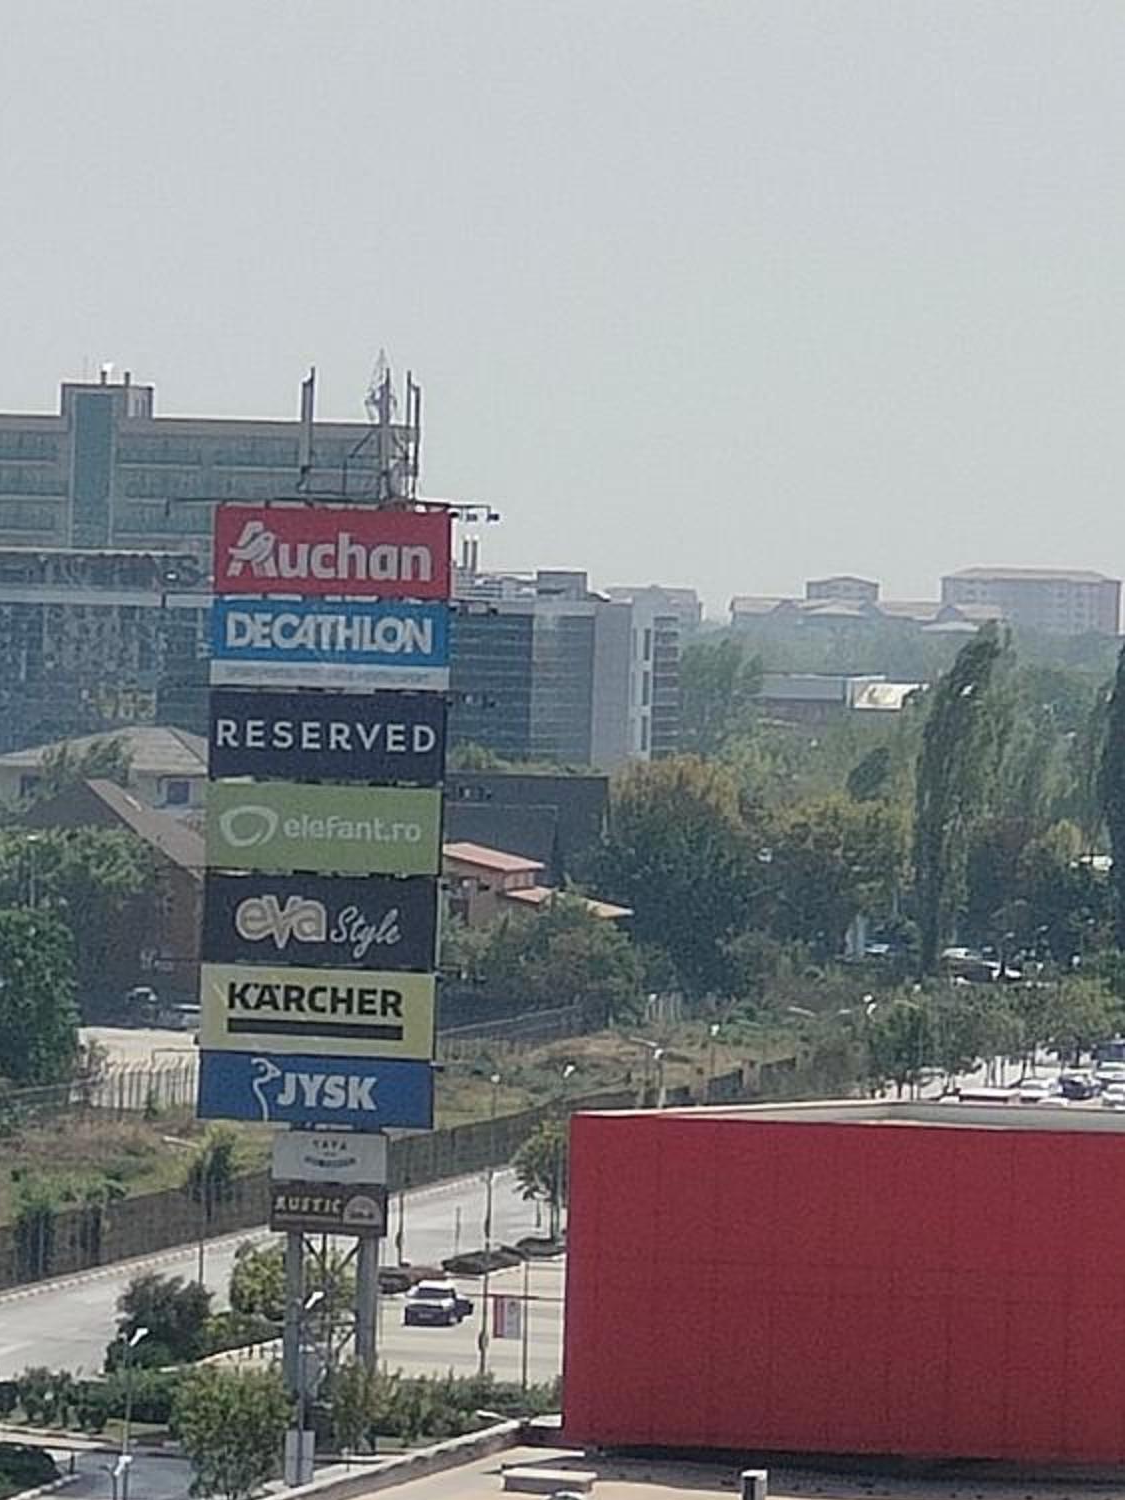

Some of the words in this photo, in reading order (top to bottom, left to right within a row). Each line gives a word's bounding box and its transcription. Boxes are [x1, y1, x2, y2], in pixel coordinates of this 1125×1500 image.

[228, 521, 432, 582] Auchan
[227, 612, 432, 654] DECATHLON
[216, 720, 437, 752] RESERVED
[283, 815, 422, 843] elefant.ro
[235, 895, 327, 948] eva
[330, 905, 402, 959] Style
[227, 981, 403, 1018] KÄRCHER
[278, 1071, 377, 1111] JYSK
